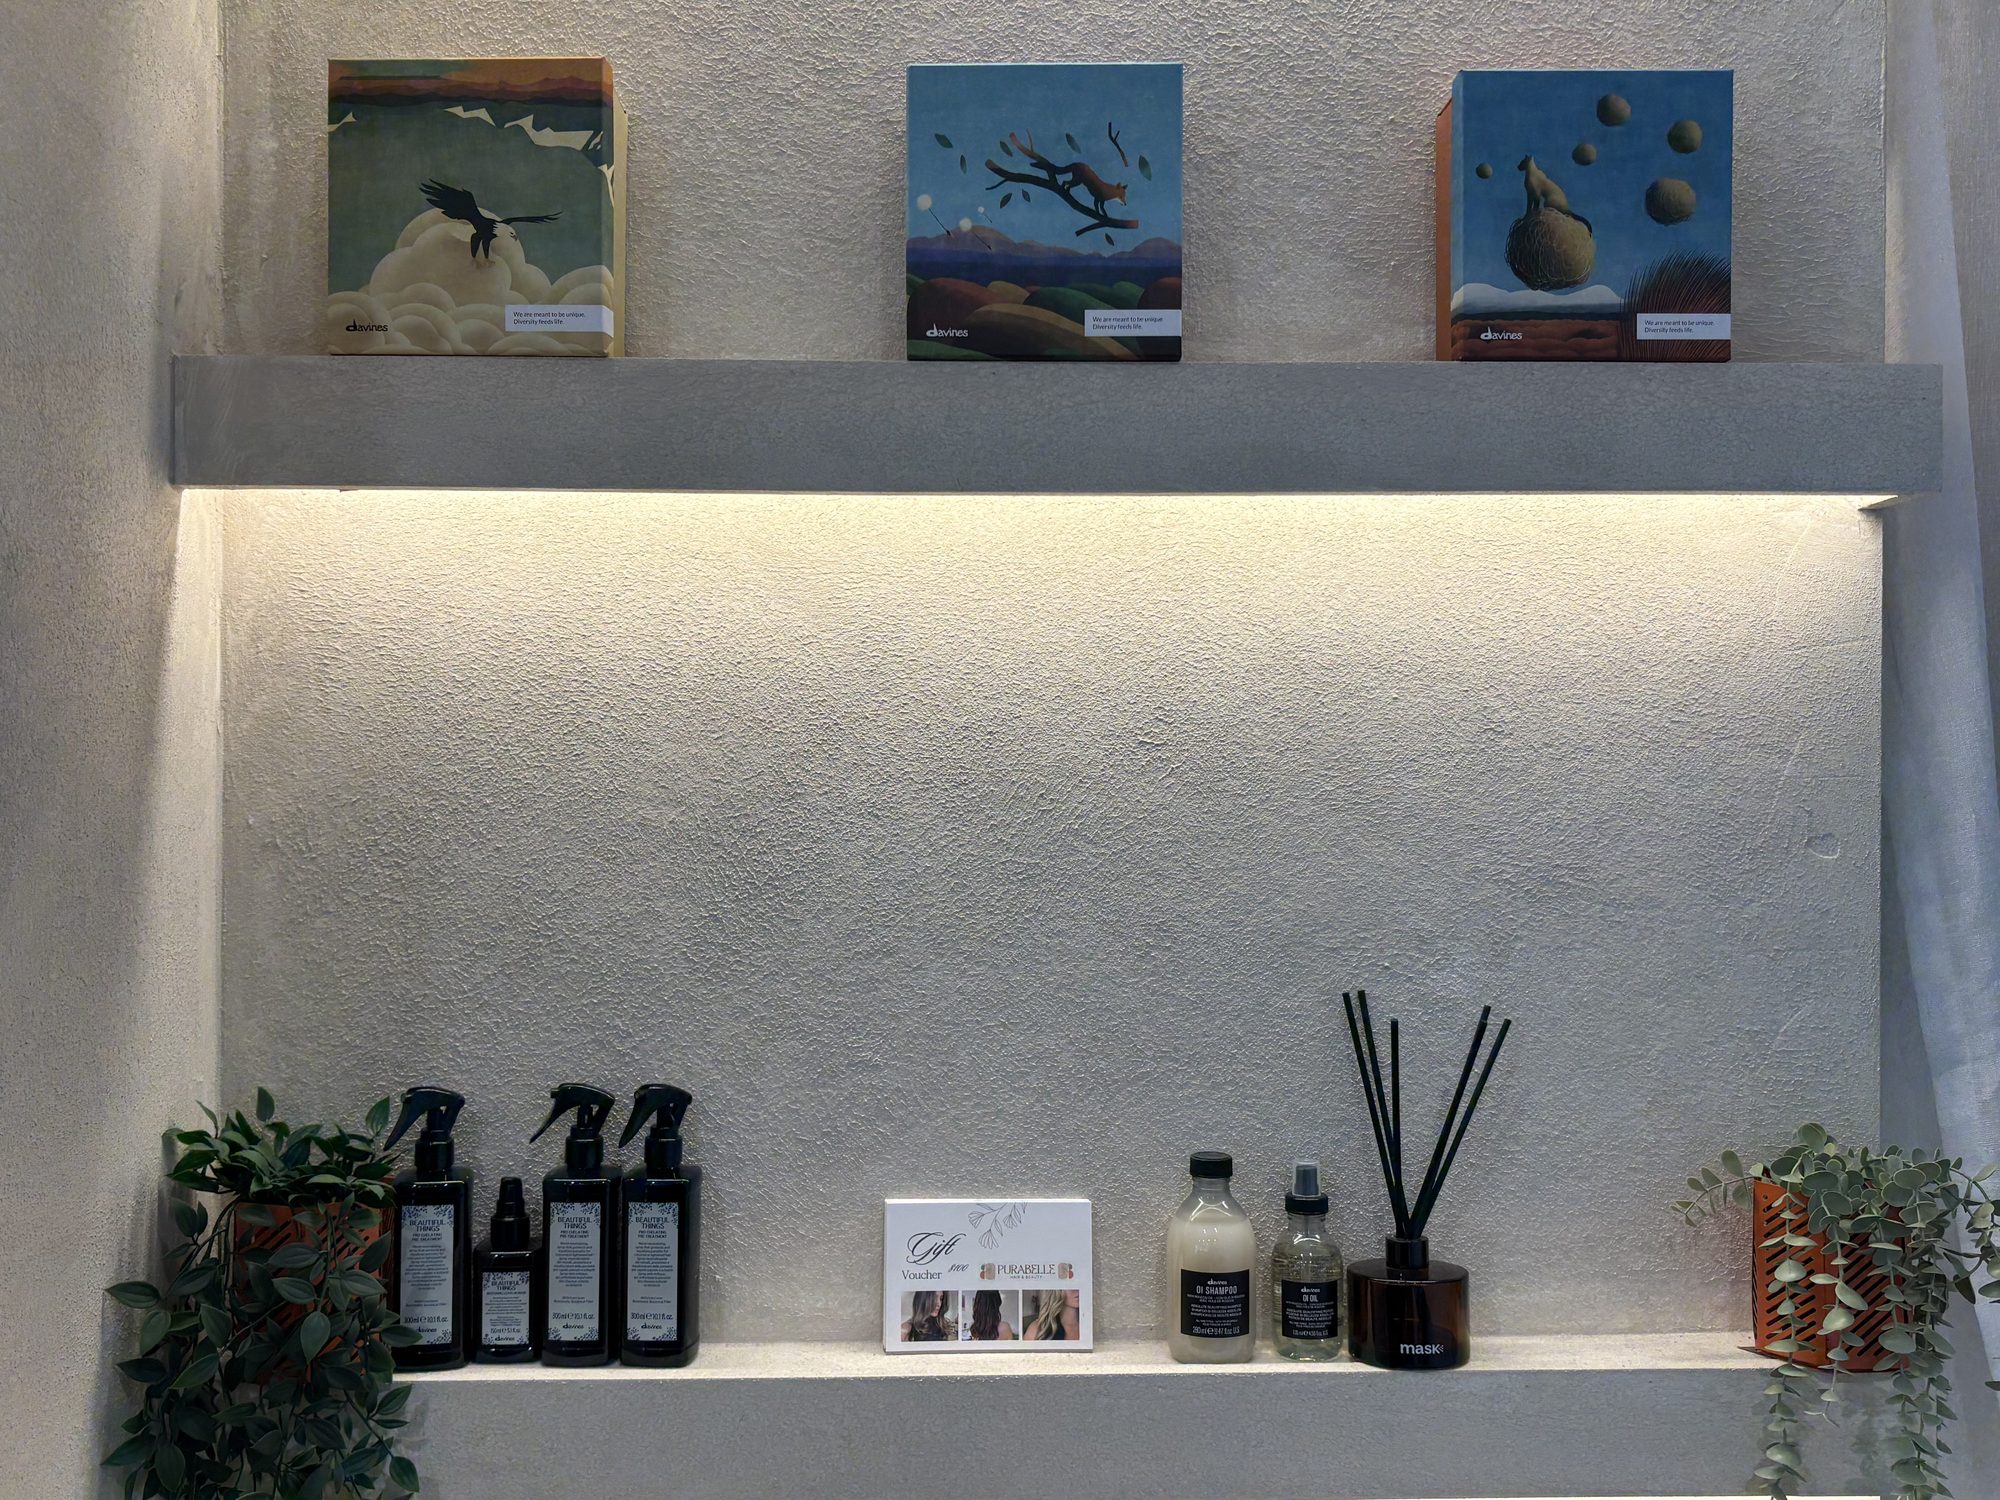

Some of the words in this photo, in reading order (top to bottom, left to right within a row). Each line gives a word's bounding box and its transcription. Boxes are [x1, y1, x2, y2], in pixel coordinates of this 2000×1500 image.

[346, 318, 388, 332] davines
[926, 323, 968, 337] davines
[1480, 326, 1523, 340] davines
[906, 1232, 967, 1266] Gift
[948, 1264, 969, 1272] $100
[997, 1264, 1056, 1275] PURABELLE
[902, 1270, 942, 1280] Voucher
[1205, 1286, 1238, 1295] SHAMPOO
[1309, 1294, 1319, 1302] OIL
[1400, 1344, 1441, 1355] mask
